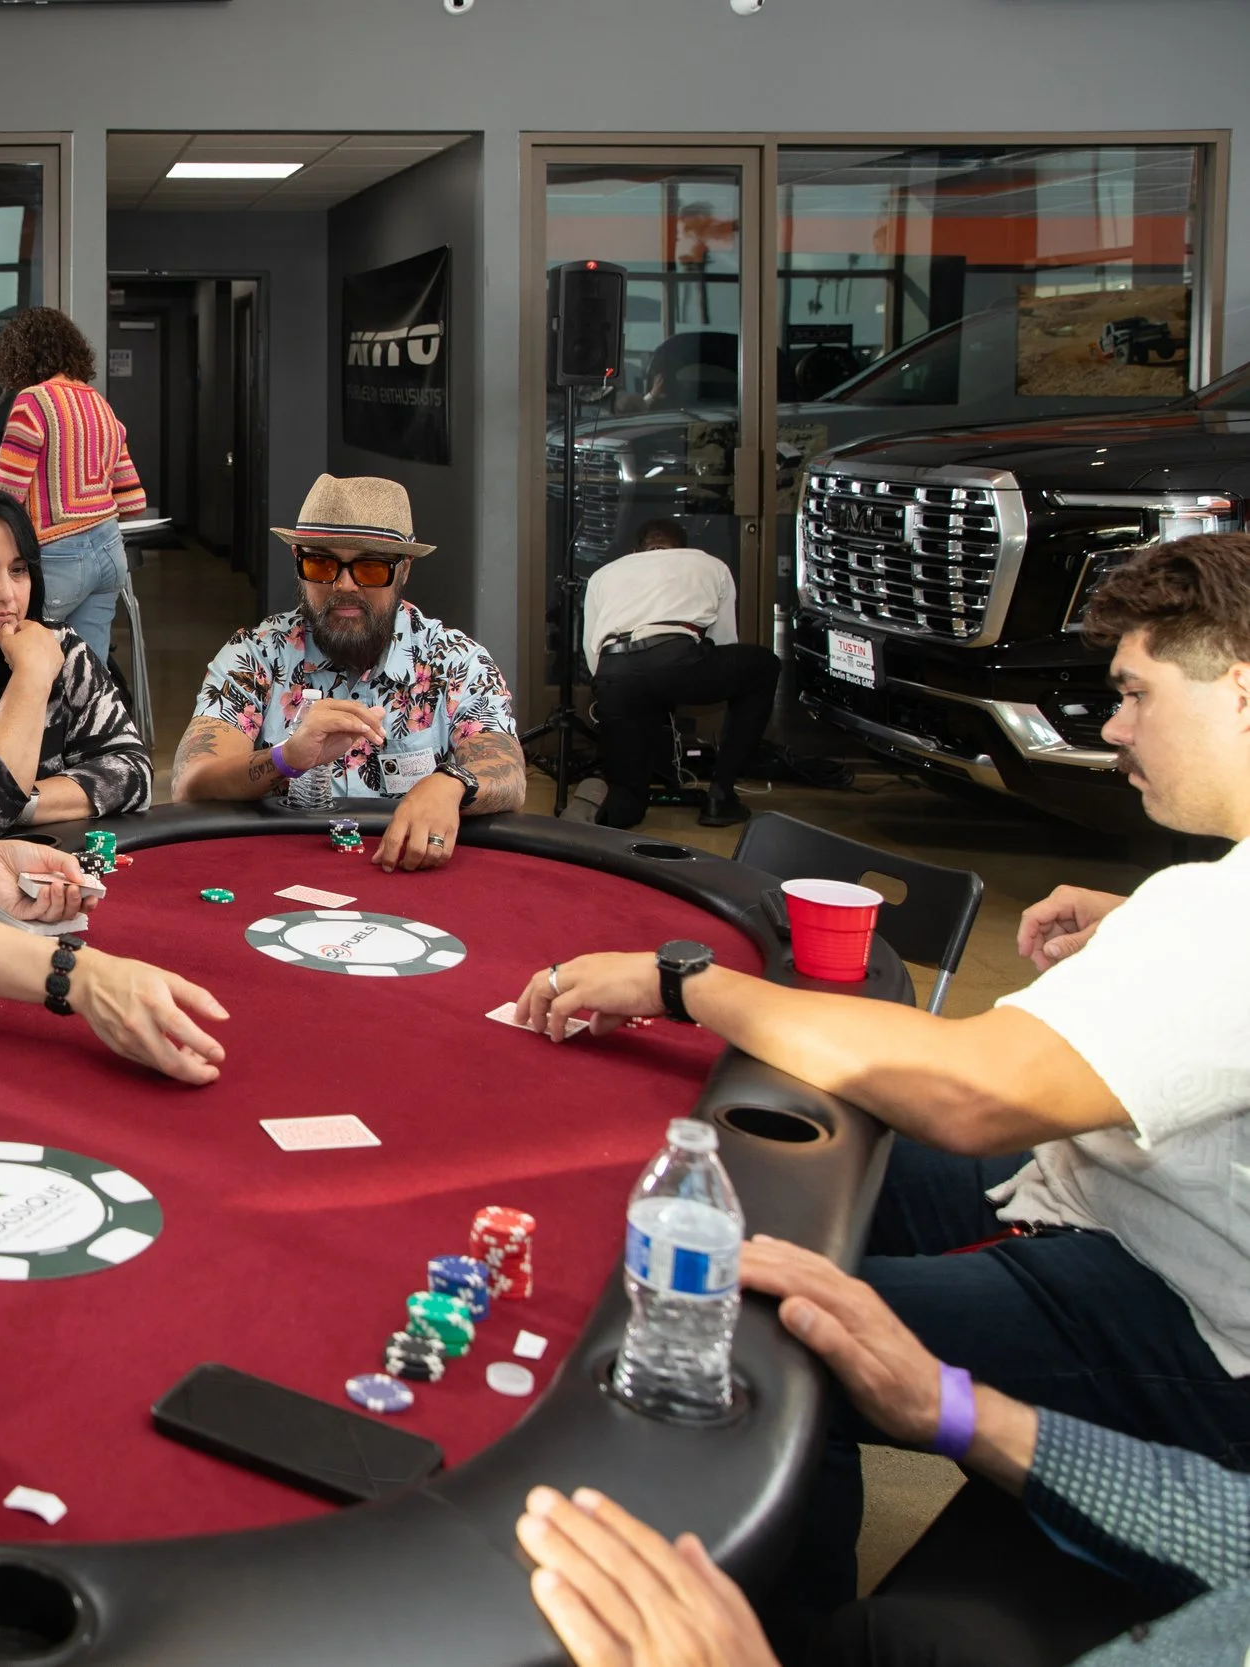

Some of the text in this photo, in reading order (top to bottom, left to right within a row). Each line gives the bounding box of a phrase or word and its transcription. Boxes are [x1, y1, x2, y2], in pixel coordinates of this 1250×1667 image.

[824, 500, 905, 538] GMC
[838, 640, 866, 656] TUSTIN
[856, 660, 872, 671] GMC
[340, 924, 378, 949] FUELS
